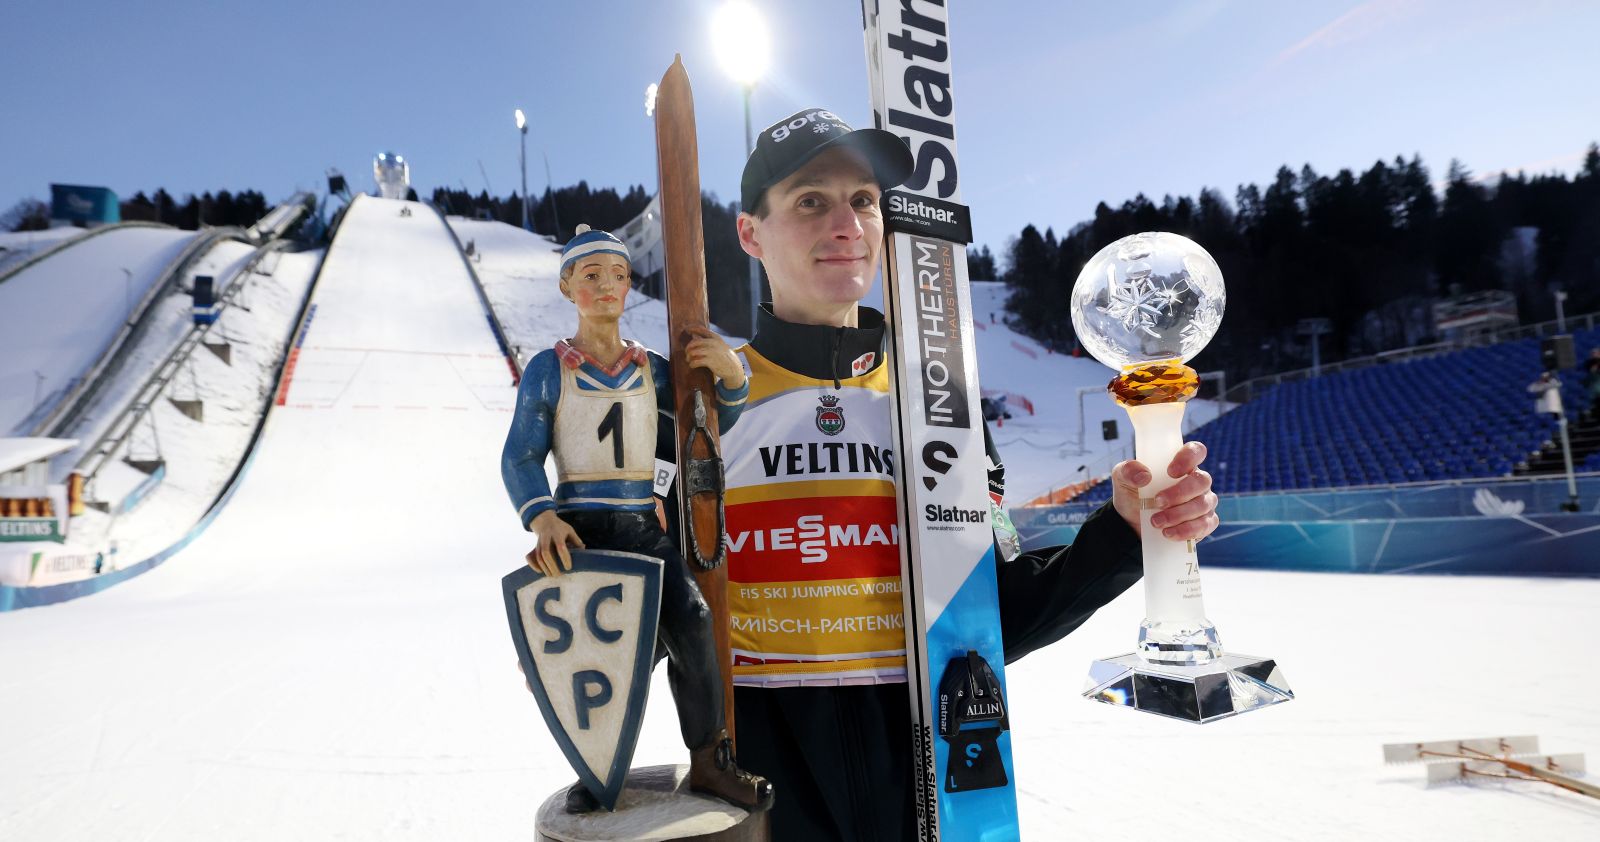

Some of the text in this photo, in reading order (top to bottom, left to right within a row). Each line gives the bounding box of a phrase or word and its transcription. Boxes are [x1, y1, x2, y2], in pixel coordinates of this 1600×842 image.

[888, 195, 954, 224] Slatnar
[940, 246, 958, 339] HAUSTÜREN
[917, 241, 953, 423] INOTHERM
[597, 401, 624, 469] 1
[759, 442, 894, 477] VELTINS
[925, 503, 987, 523] Slatnar
[725, 515, 901, 564] VIESSMA
[740, 588, 759, 599] FIS
[764, 587, 787, 599] SKI
[791, 584, 859, 599] JUMPING
[572, 669, 613, 730] P
[940, 694, 949, 734] Slatnar
[966, 702, 1000, 716] ALL IN
